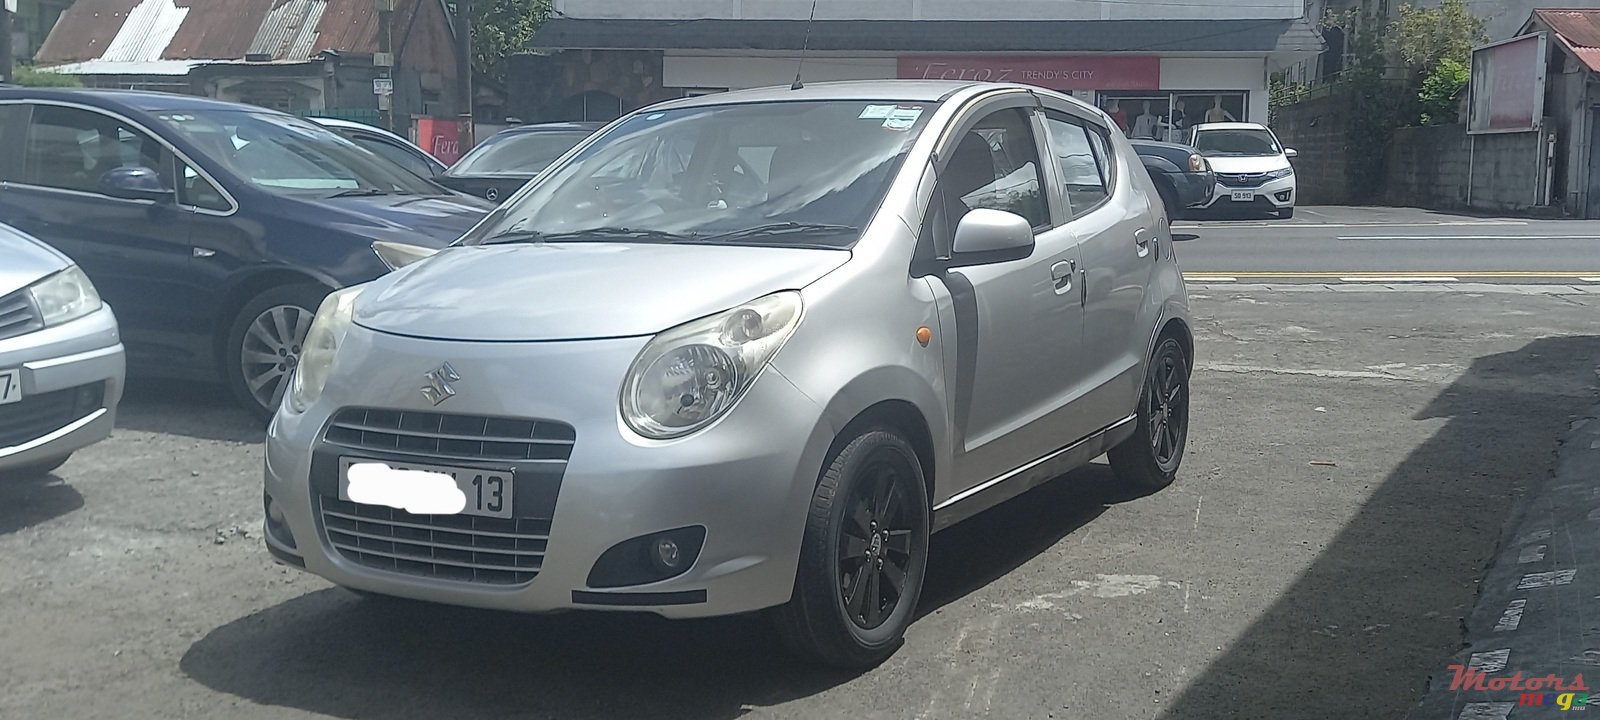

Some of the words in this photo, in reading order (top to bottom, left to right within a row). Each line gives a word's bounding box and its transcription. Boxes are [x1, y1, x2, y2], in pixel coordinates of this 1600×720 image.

[1021, 70, 1069, 80] TRENDY'S
[1071, 70, 1094, 80] CITY
[472, 474, 503, 512] 13
